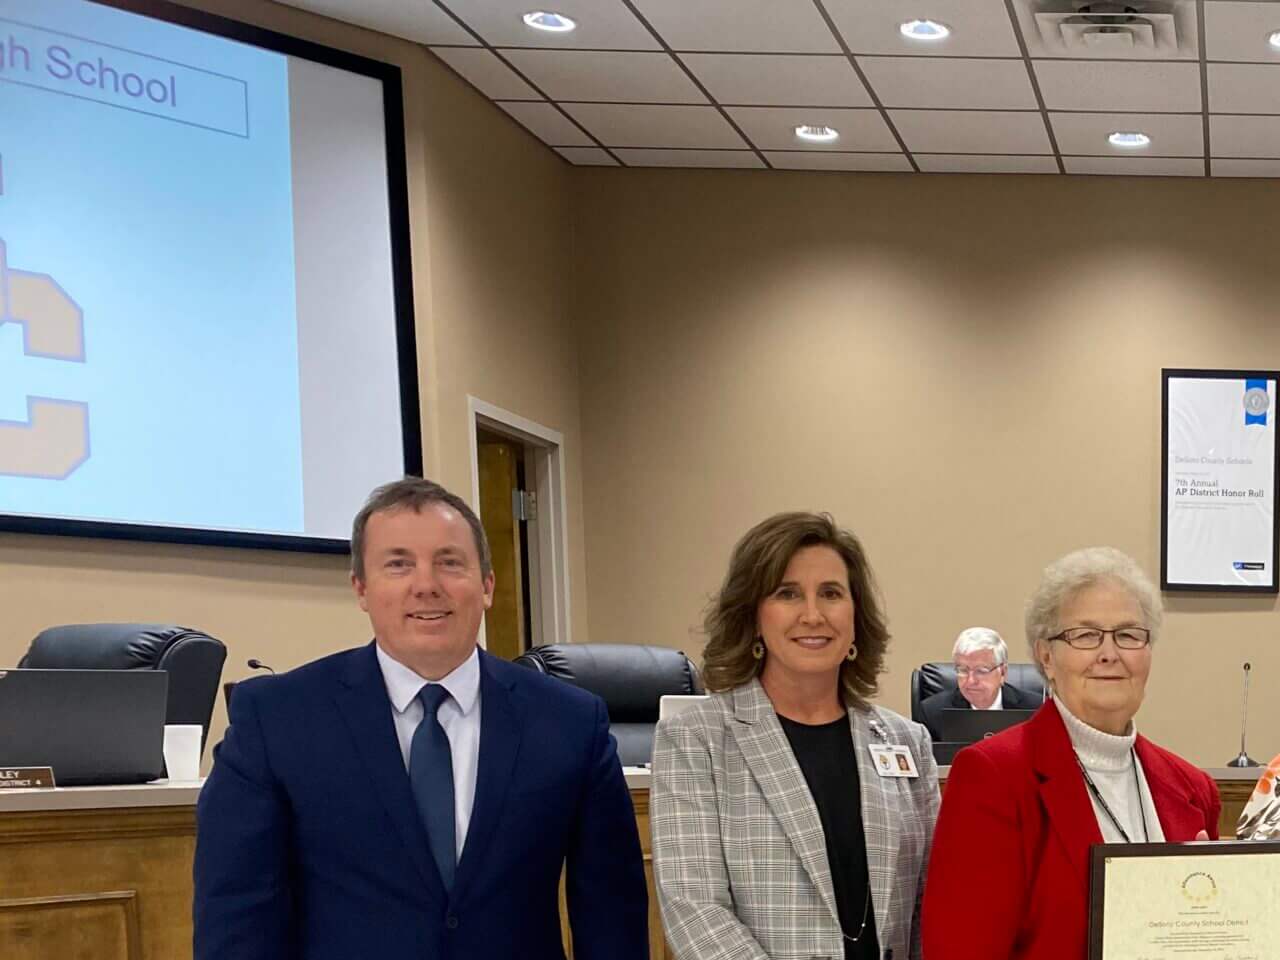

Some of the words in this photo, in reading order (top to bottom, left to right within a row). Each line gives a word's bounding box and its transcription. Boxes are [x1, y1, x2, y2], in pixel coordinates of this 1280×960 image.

[46, 45, 177, 107] School
[1175, 479, 1188, 487] 7th
[1190, 479, 1219, 487] Annual
[1175, 488, 1188, 496] AP
[1190, 488, 1220, 497] District
[1221, 489, 1246, 498] Honor
[1248, 489, 1265, 498] Roll
